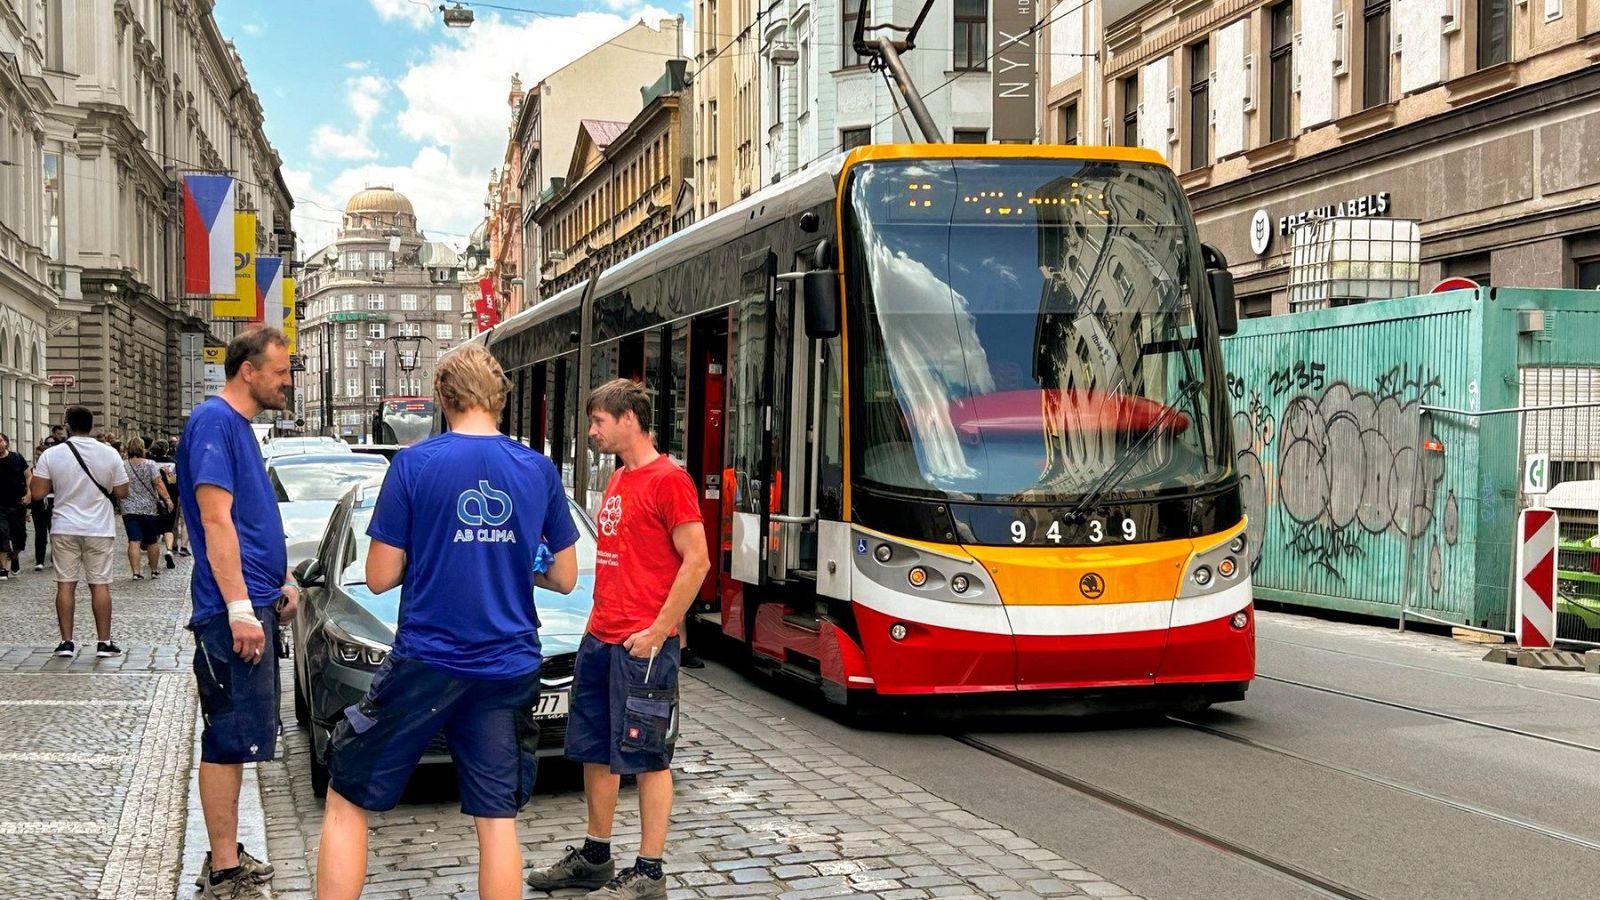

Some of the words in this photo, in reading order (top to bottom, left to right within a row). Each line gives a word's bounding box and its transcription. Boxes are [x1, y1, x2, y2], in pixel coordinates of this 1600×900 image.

[999, 29, 1030, 98] NYX
[453, 528, 474, 543] AB
[477, 528, 517, 543] CLIMA
[1010, 518, 1137, 543] 9439
